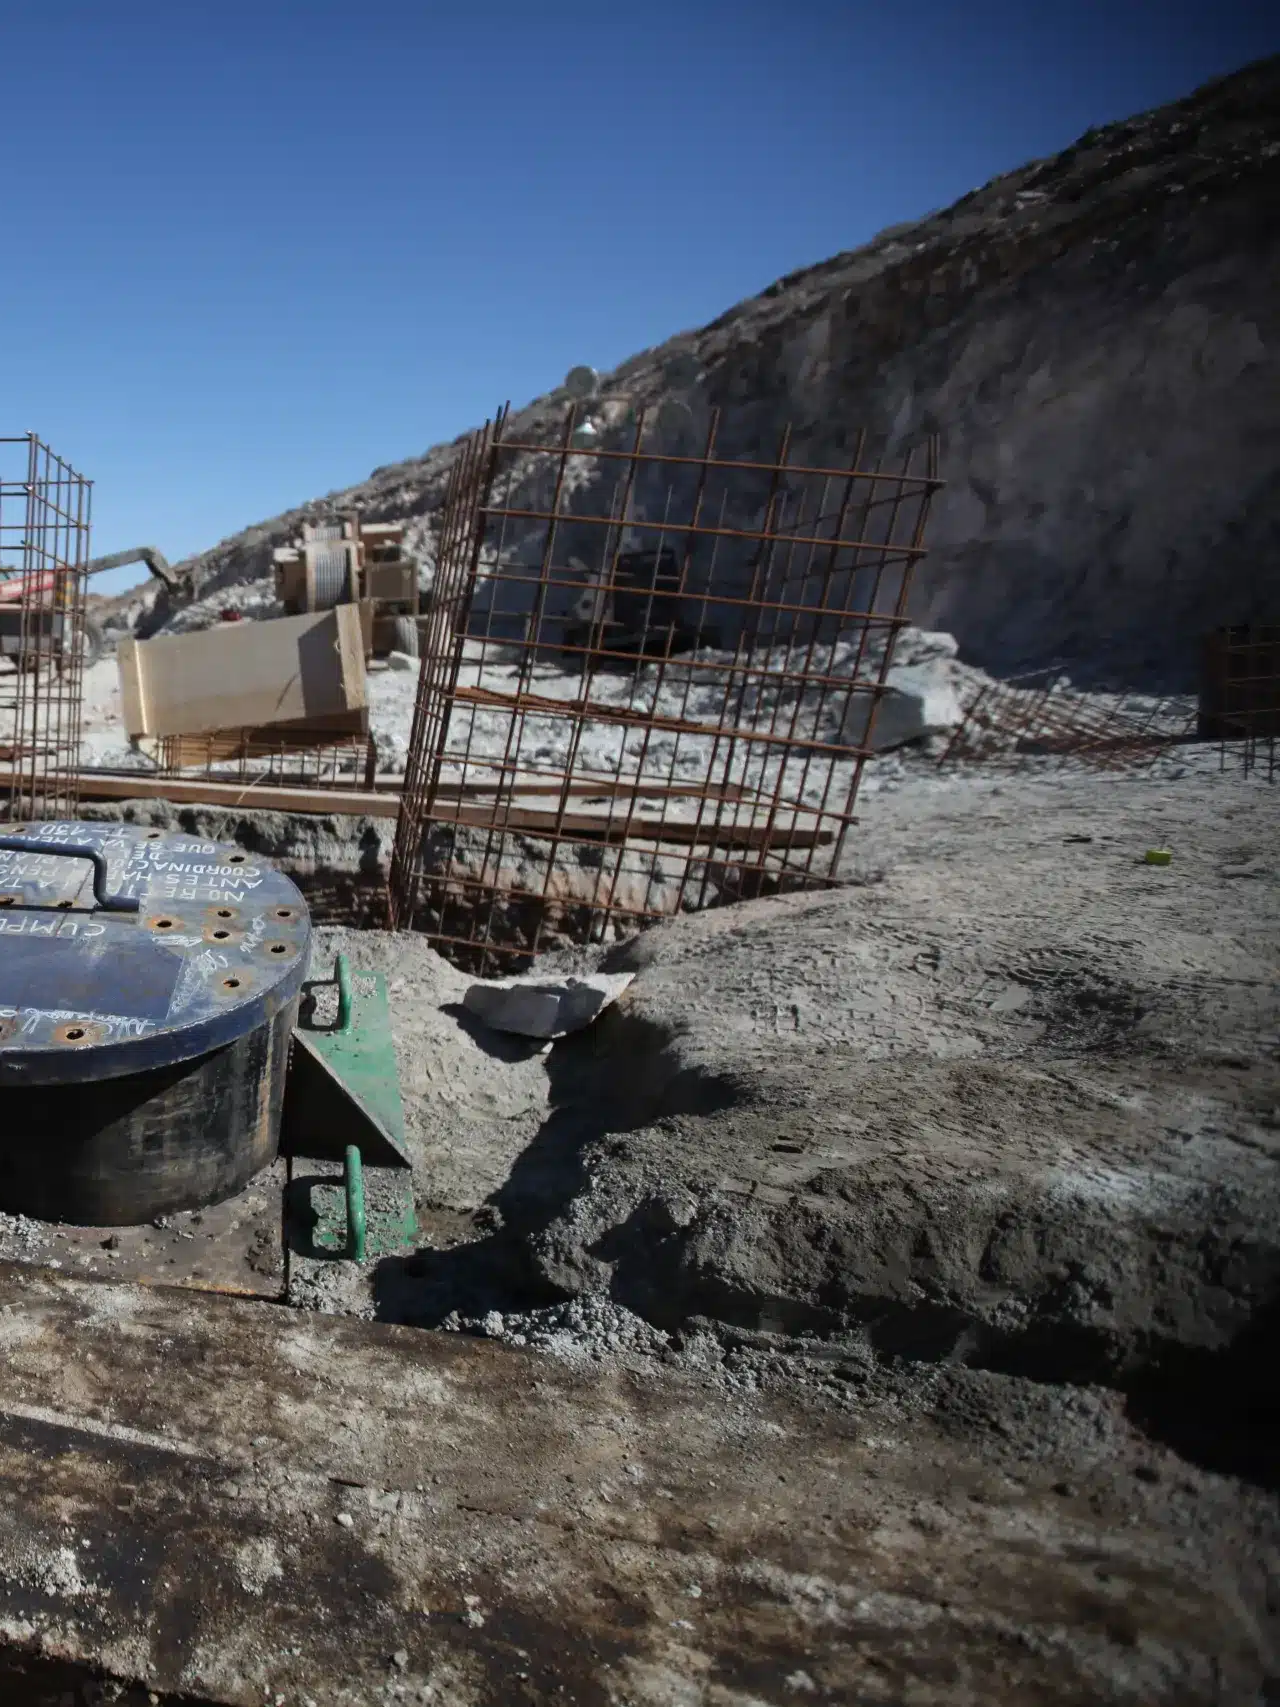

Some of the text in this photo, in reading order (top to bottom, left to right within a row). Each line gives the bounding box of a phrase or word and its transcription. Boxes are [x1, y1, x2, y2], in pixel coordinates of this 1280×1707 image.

[134, 840, 165, 851] SE
[169, 842, 217, 855] QUE
[164, 873, 263, 889] ANTES
[208, 889, 245, 902] NO
